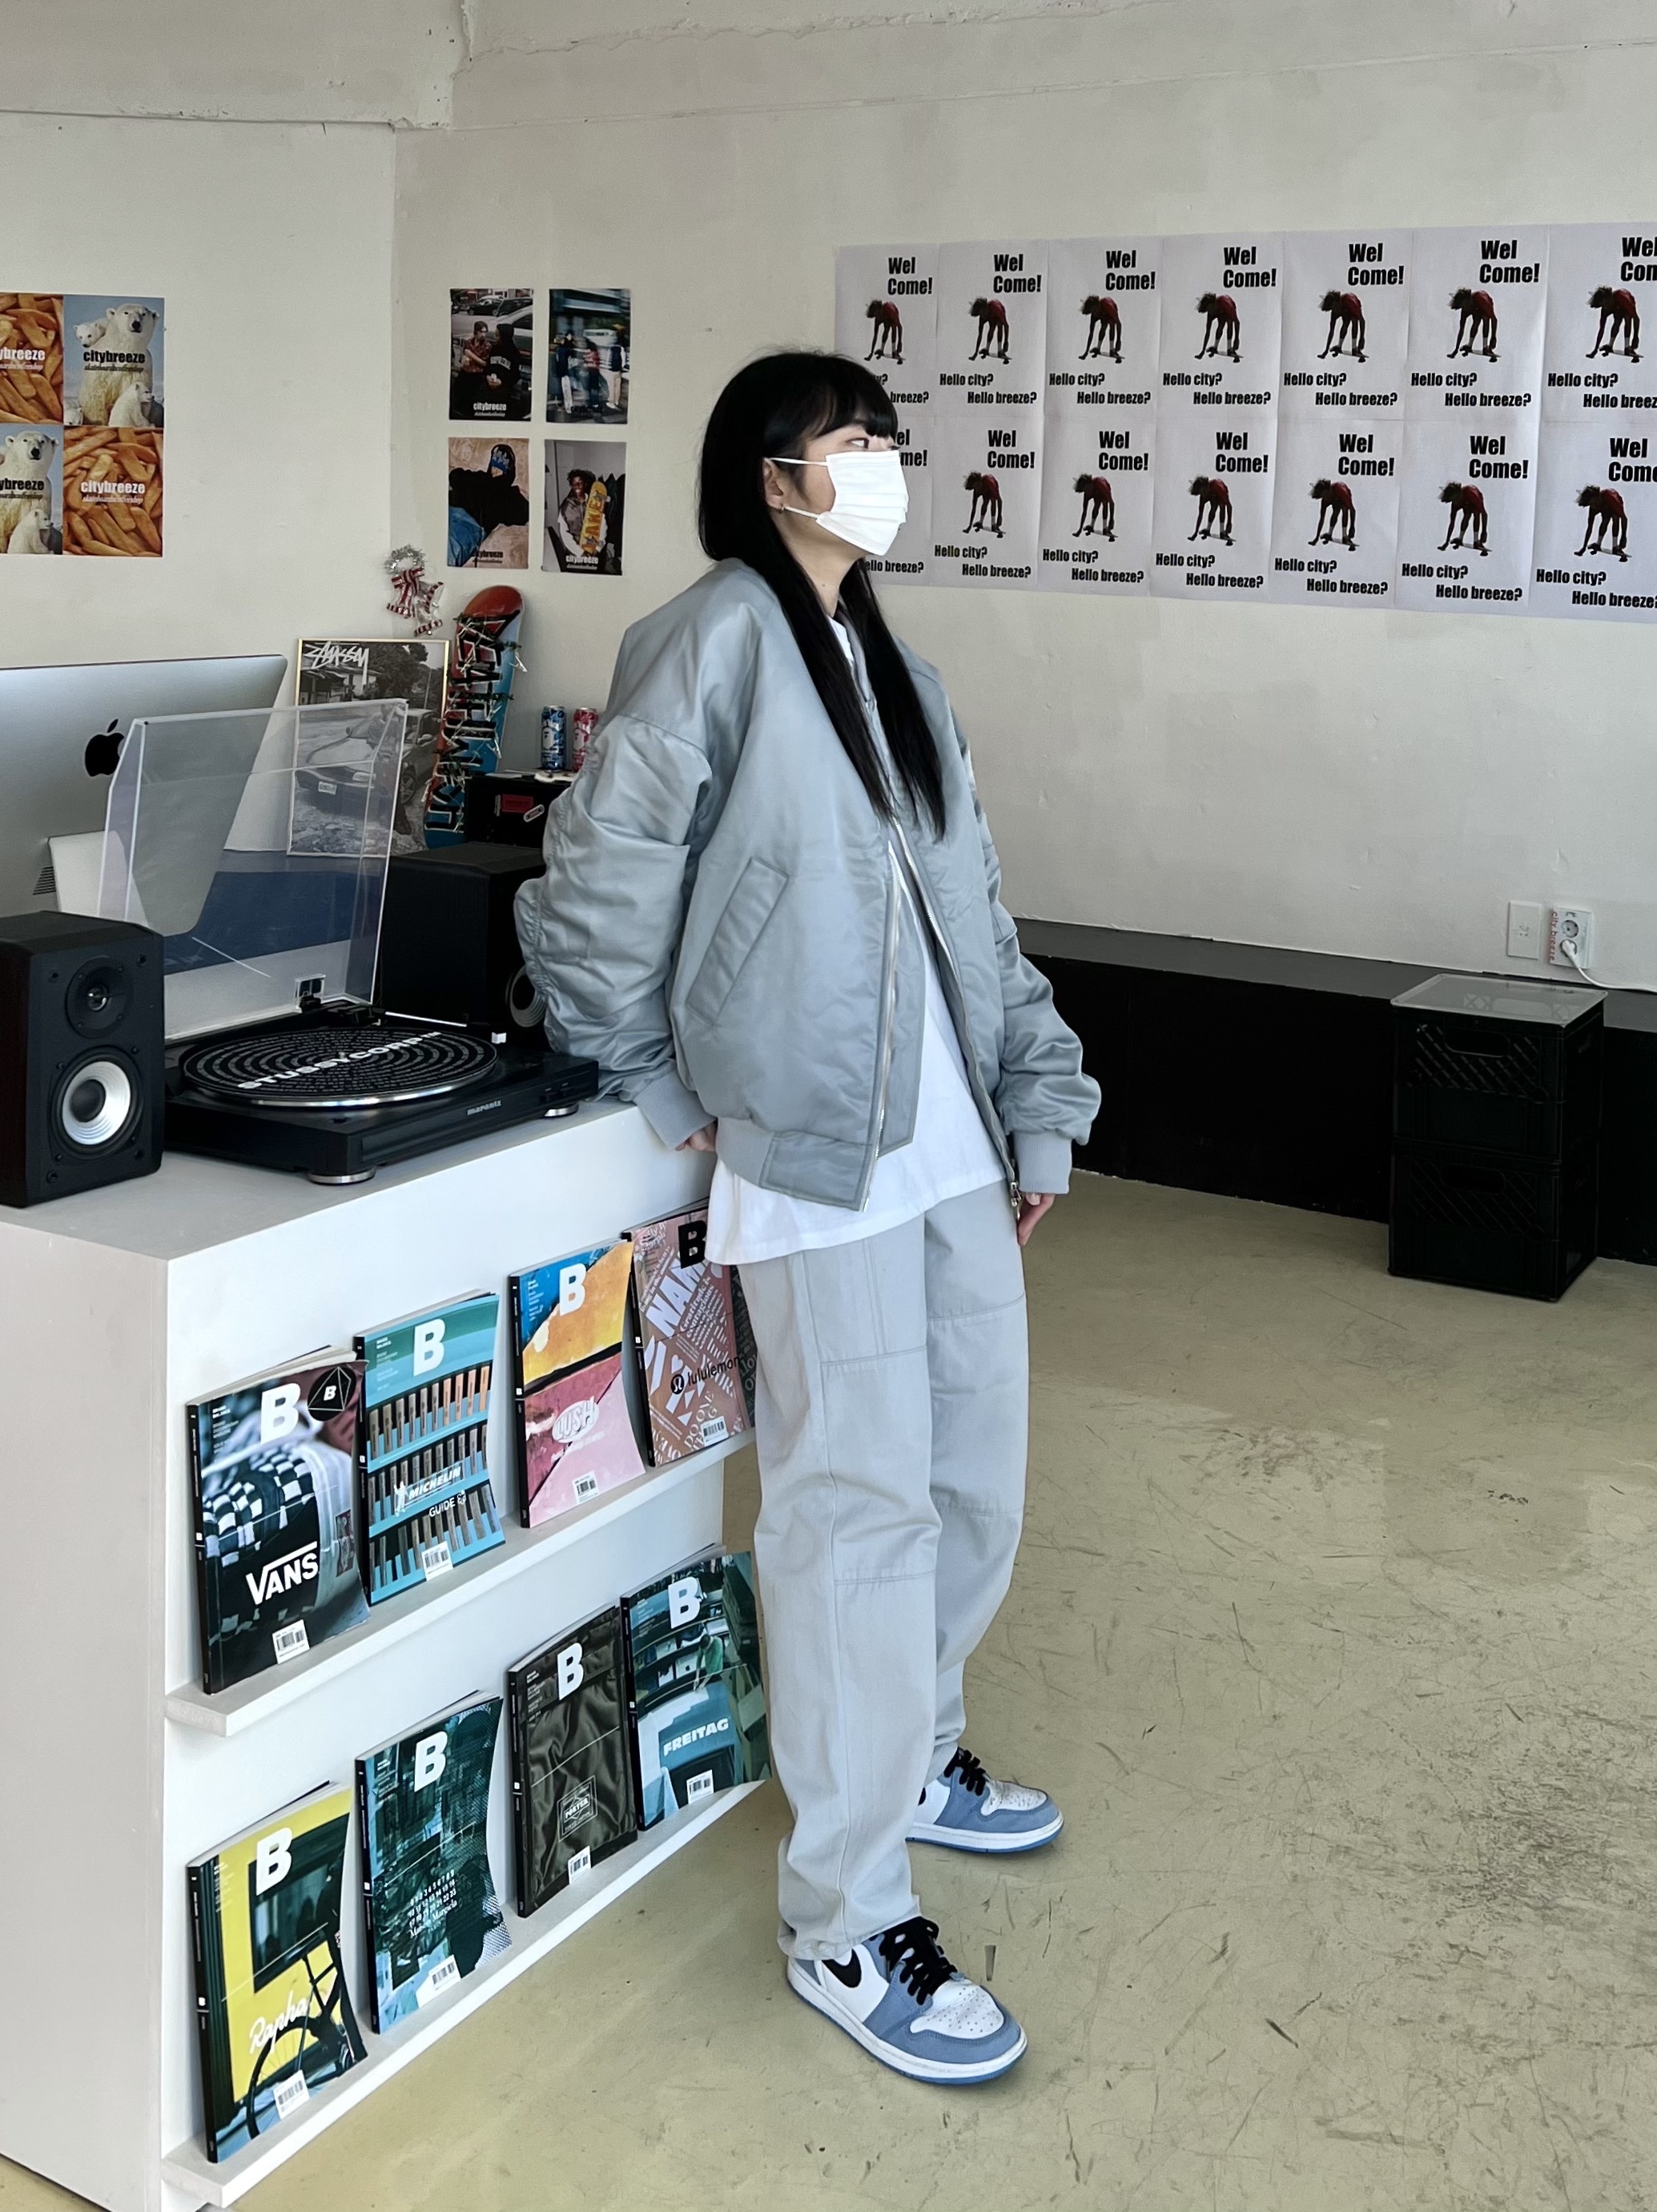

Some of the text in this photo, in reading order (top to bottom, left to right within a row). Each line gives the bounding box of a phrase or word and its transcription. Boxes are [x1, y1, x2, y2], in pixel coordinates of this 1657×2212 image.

[1105, 249, 1136, 269] Wel
[1223, 246, 1257, 266] Wel
[1348, 242, 1383, 263] Wel
[1481, 239, 1518, 260] Wel
[888, 256, 916, 275] Wel
[993, 253, 1024, 272] Wel
[1105, 271, 1156, 292] Come!
[1223, 267, 1277, 288] Come!
[1347, 265, 1405, 287] Come!
[1479, 263, 1540, 284] Come!
[887, 276, 933, 296] Come!
[993, 274, 1042, 294] Come!
[83, 350, 146, 364] citybreeze
[939, 372, 994, 388] Hello city?
[1048, 372, 1105, 387] Hello city?
[1162, 372, 1223, 387] Hello city?
[1283, 372, 1347, 388] Hello city?
[1410, 372, 1478, 388] Hello city?
[1547, 372, 1619, 389] Hello city?
[890, 391, 930, 405] breeze?
[967, 391, 1037, 404] Hello breeze?
[1076, 391, 1152, 404] Hello breeze?
[1192, 391, 1271, 405] Hello breeze?
[1315, 392, 1398, 406] Hello breeze?
[1444, 392, 1532, 407] Hello breeze?
[1583, 393, 1619, 408] Hello
[896, 428, 911, 446] el
[987, 429, 1017, 448] Wel
[1099, 430, 1130, 449] Wel
[1216, 432, 1249, 451] Wel
[1339, 433, 1374, 453] Wel
[1470, 435, 1506, 456] Wel
[1609, 437, 1648, 458] Wel
[899, 449, 928, 467] me!
[987, 450, 1036, 469] Come!
[1098, 452, 1149, 471] Come!
[1215, 453, 1269, 473] Come!
[1337, 456, 1395, 477] Come!
[1469, 458, 1529, 479] Come!
[80, 481, 146, 494] citybreeze
[934, 545, 988, 560] Hello city?
[1042, 548, 1099, 565] Hello city?
[1156, 553, 1216, 569] Hello city?
[865, 559, 924, 574] ello breeze?
[962, 563, 1032, 579] Hello breeze?
[1274, 557, 1337, 574] Hello city?
[1402, 563, 1469, 581] Hello city?
[1071, 567, 1144, 584] Hello breeze?
[1186, 573, 1264, 589] Hello breeze?
[1536, 569, 1607, 586] Hello city?
[1306, 577, 1389, 595] Hello breeze?
[1435, 584, 1523, 601] Hello breeze?
[1571, 590, 1607, 606] Hello
[467, 1100, 501, 1116] marantz
[678, 1220, 707, 1269] B
[559, 1263, 586, 1317] B
[413, 1318, 445, 1377] B
[687, 1357, 740, 1386] lululemon
[324, 1385, 336, 1401] B
[260, 1382, 301, 1444] B
[556, 1396, 594, 1439] LUSH
[408, 1466, 461, 1500] MICHELIN
[428, 1497, 456, 1518] GUIDE
[246, 1542, 319, 1605] VANS
[668, 1577, 700, 1629] B
[557, 1643, 584, 1700] B
[663, 1717, 730, 1756] FREITAG
[414, 1731, 448, 1792] B
[565, 1797, 589, 1819] PORTER
[256, 1828, 292, 1896] B
[250, 1990, 309, 2054] Rapha
